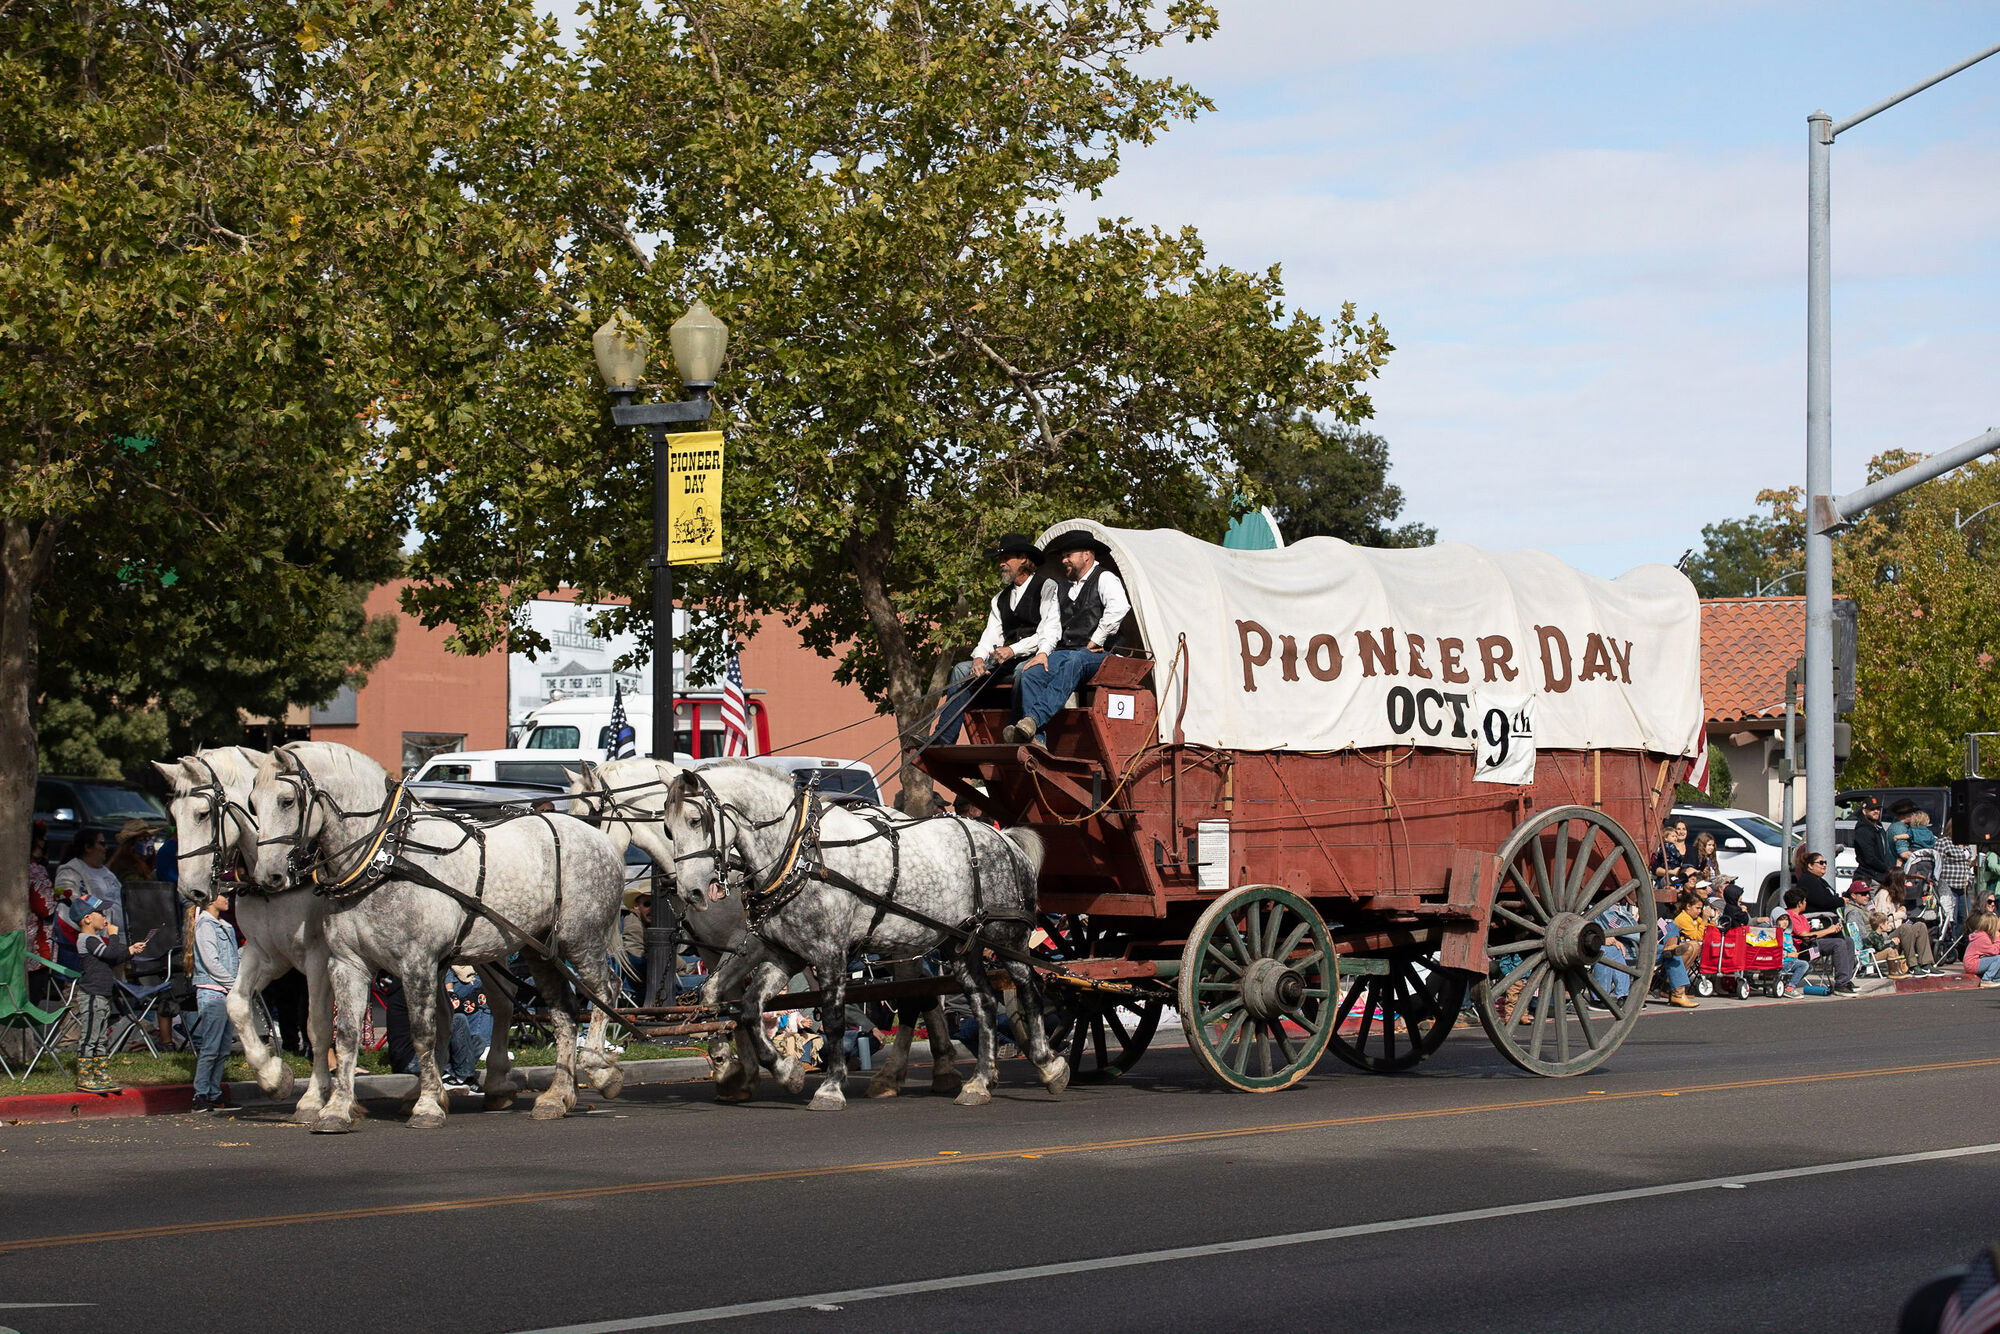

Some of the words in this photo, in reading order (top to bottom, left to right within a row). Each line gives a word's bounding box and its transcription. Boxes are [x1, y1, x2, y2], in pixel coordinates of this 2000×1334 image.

[671, 450, 720, 472] PIONEER
[684, 474, 706, 494] DAY
[557, 632, 600, 650] THEATRE
[1235, 619, 1519, 693] PIONEER
[1534, 624, 1634, 694] DAY
[1117, 701, 1125, 716] 9
[1387, 686, 1478, 739] OCT.
[1483, 709, 1532, 768] 9th
